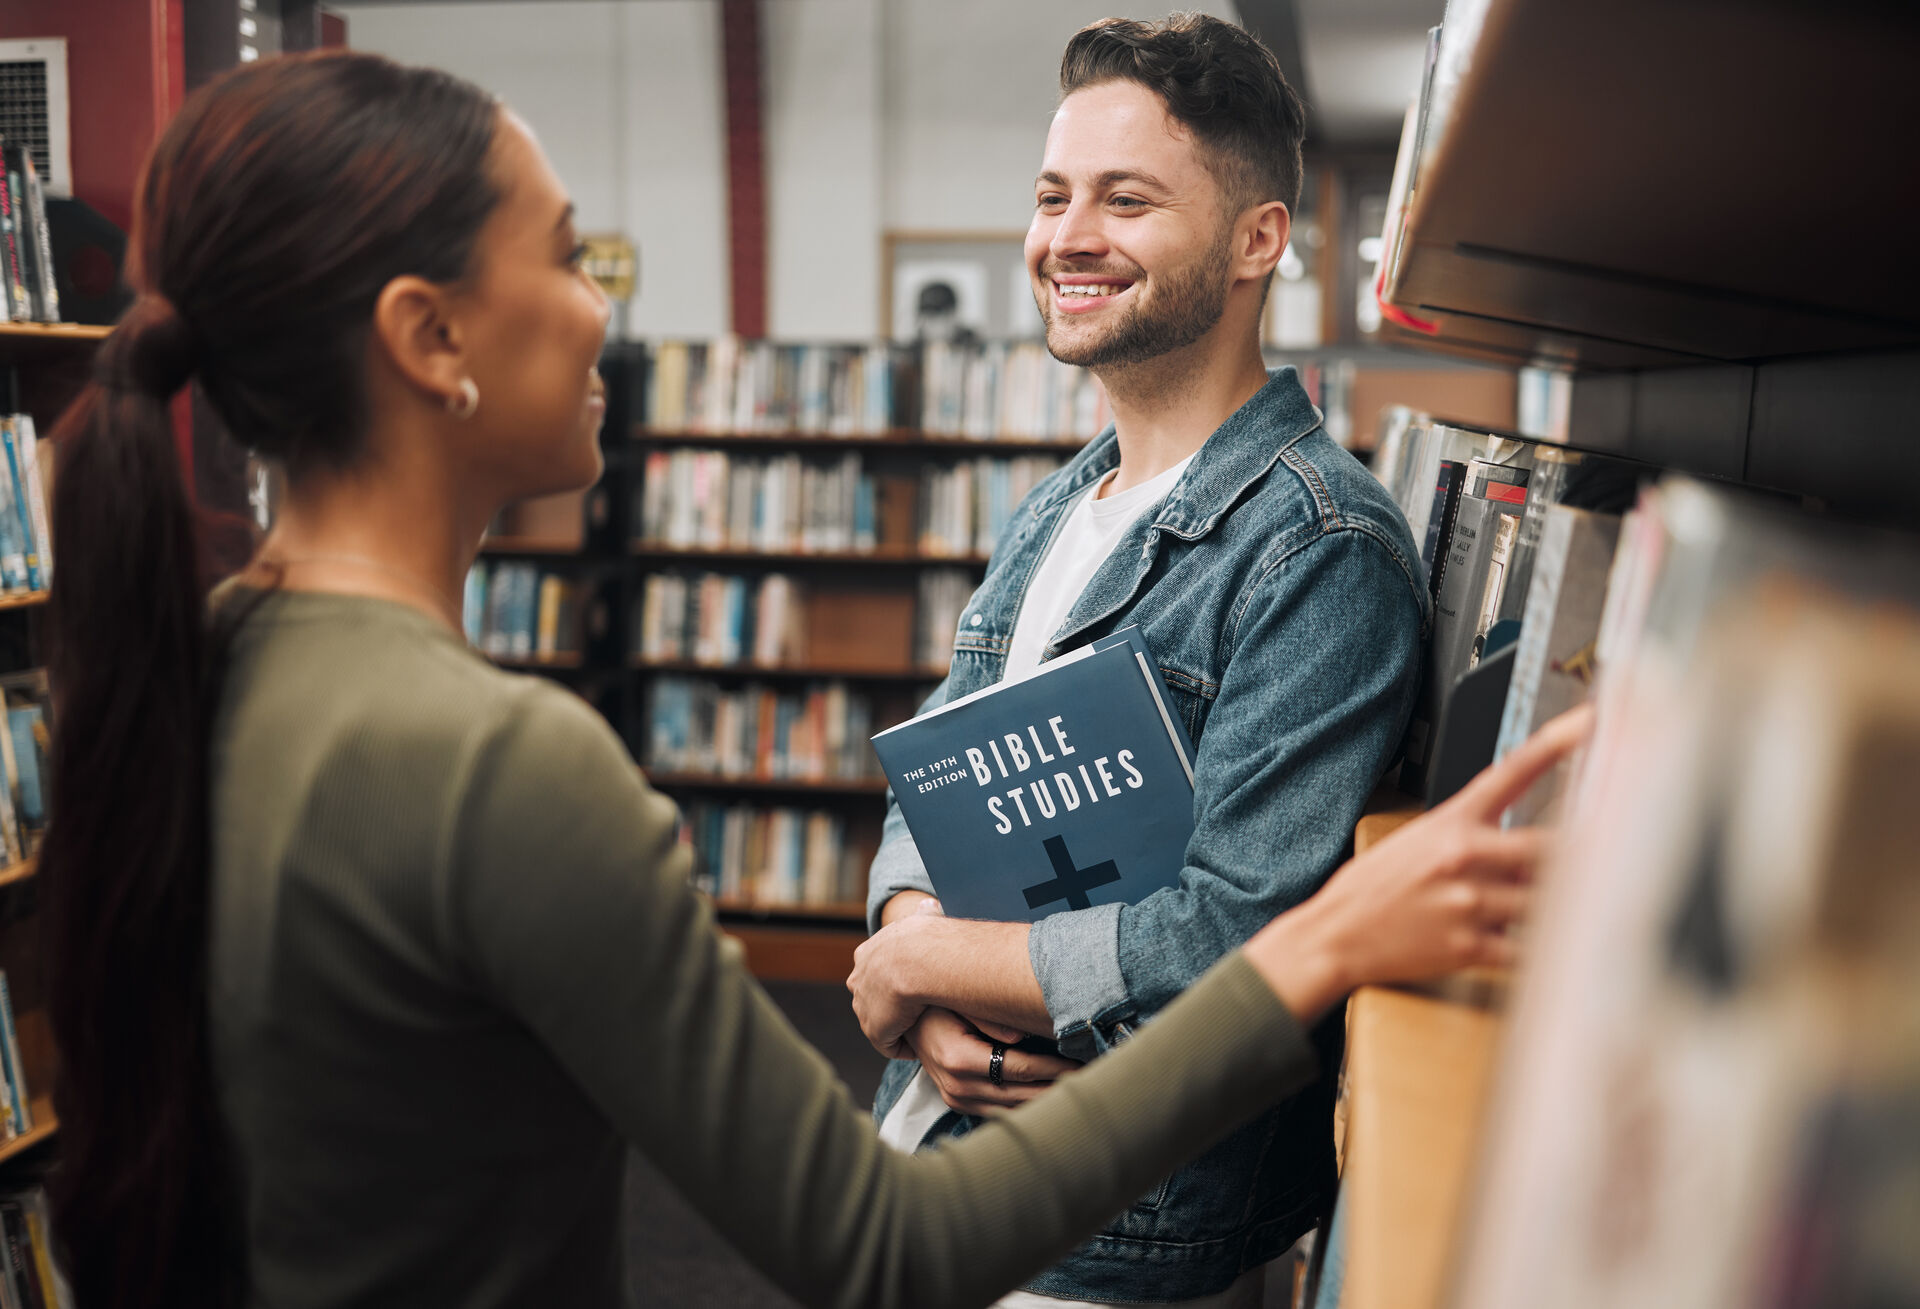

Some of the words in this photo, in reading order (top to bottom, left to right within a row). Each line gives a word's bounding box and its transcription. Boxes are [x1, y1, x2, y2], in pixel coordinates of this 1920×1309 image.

[903, 767, 926, 783] THE
[928, 755, 958, 774] 19TH
[965, 715, 1076, 787] BIBLE
[917, 768, 968, 794] EDITION
[987, 749, 1144, 835] STUDIES
